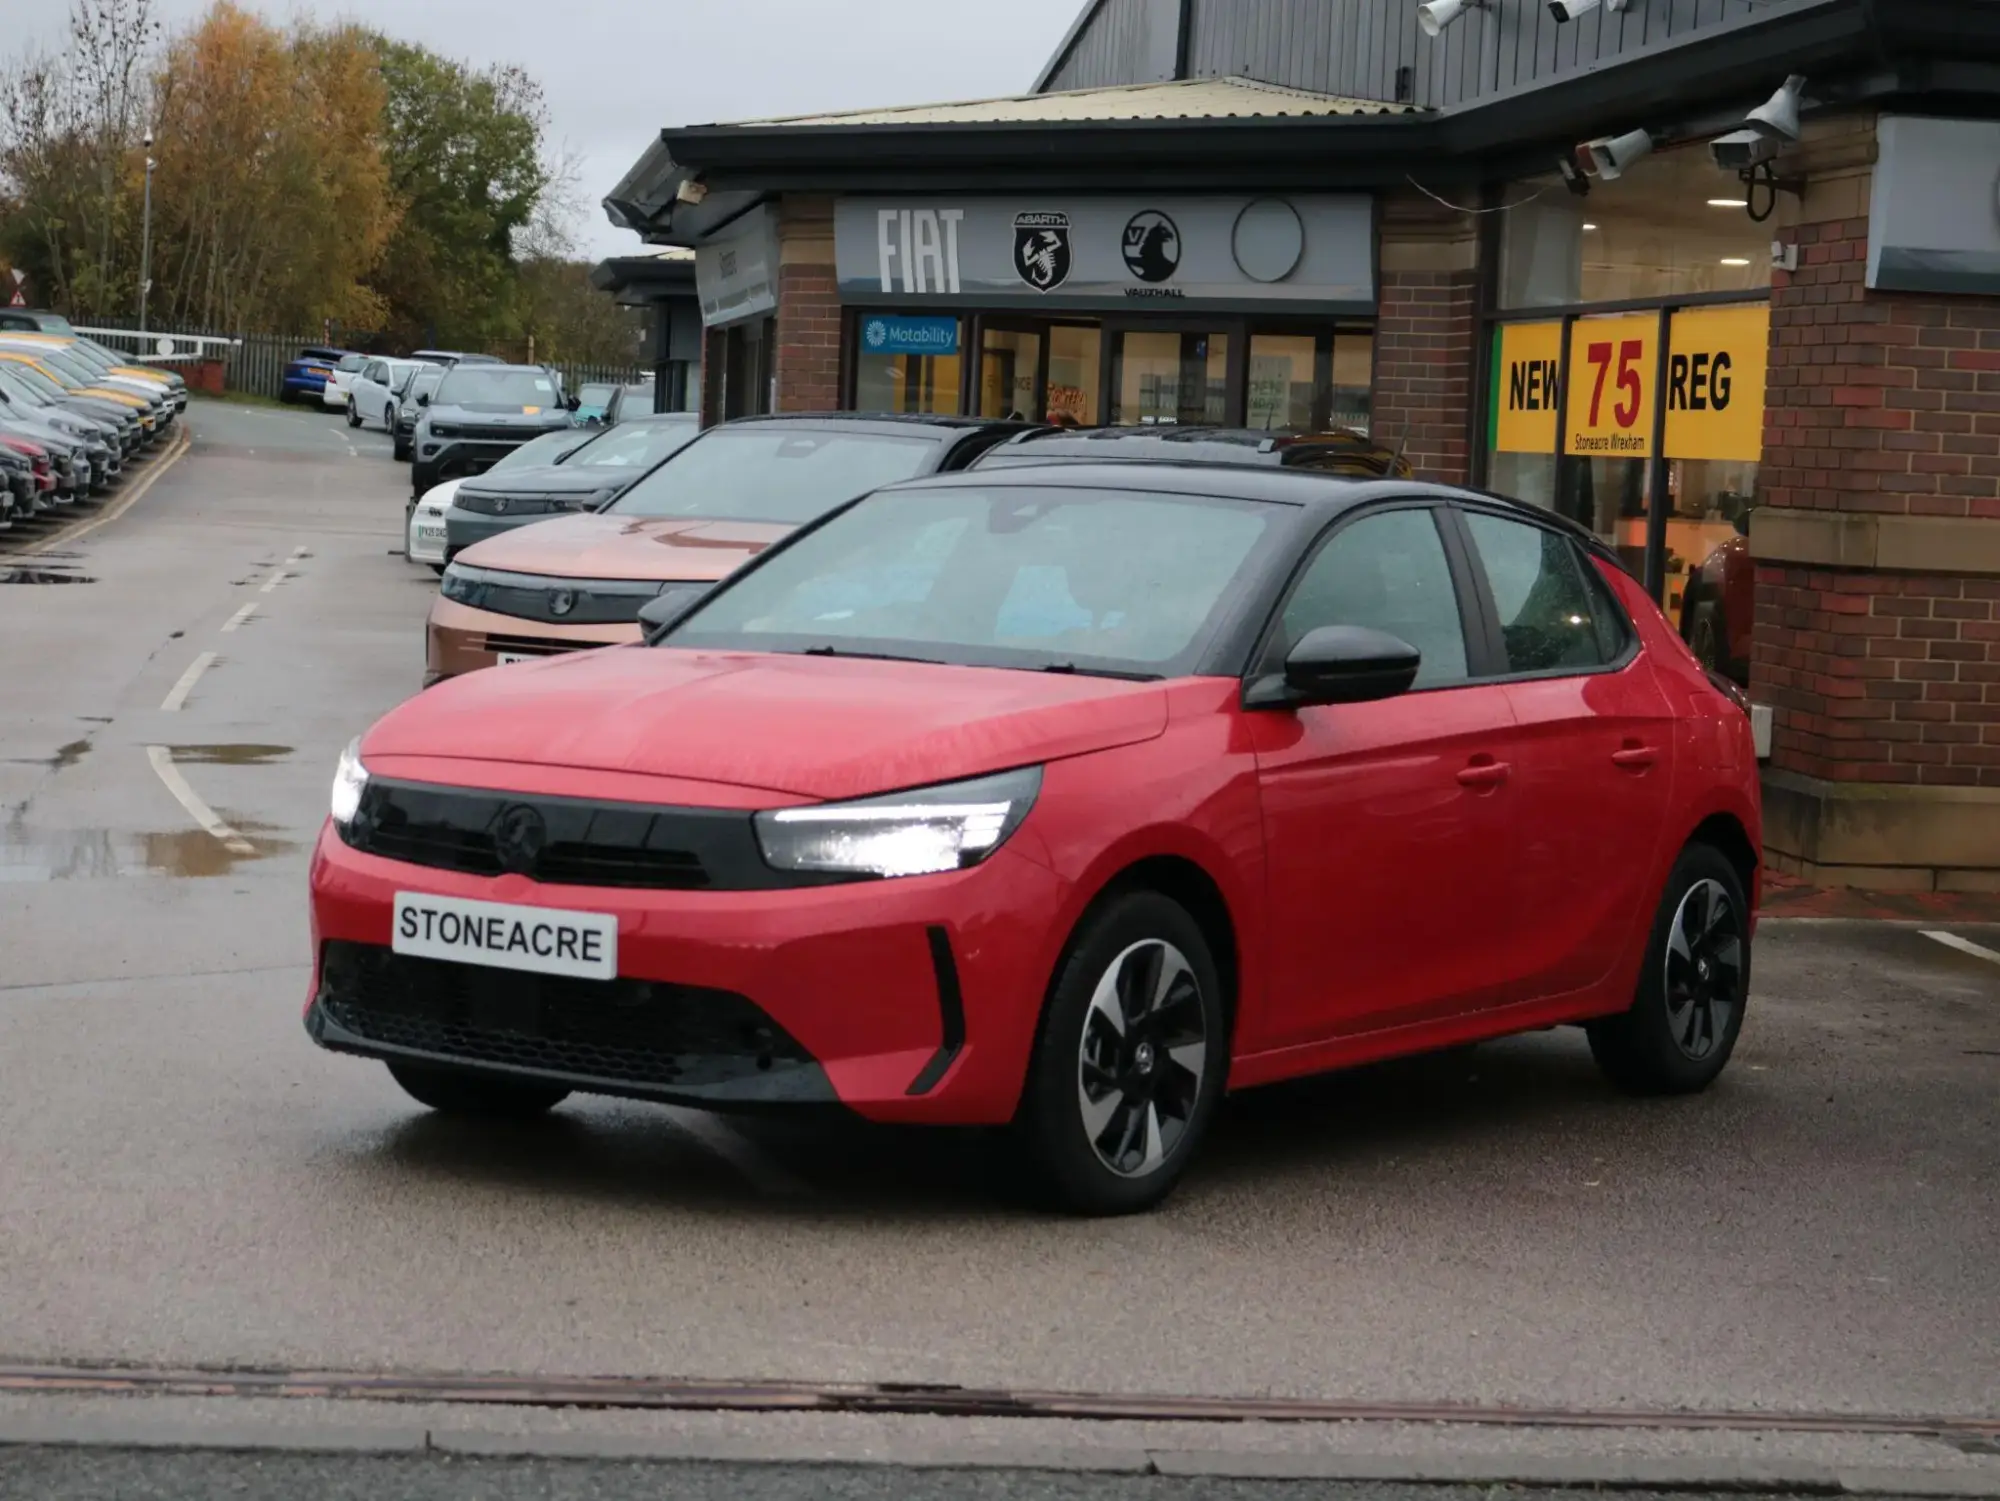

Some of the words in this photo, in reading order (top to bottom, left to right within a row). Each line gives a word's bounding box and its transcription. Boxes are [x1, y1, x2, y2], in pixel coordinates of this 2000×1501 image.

[1016, 214, 1067, 225] ABARTH
[878, 209, 964, 293] FIAT
[1124, 287, 1186, 298] VAUXHALL
[889, 327, 954, 348] Motability
[1509, 360, 1561, 411] NEW
[1587, 339, 1643, 429] 75
[1668, 351, 1732, 411] REG
[1575, 433, 1609, 451] Stoneacre
[1610, 432, 1645, 451] Wrexham
[400, 906, 603, 962] STONEACRE
